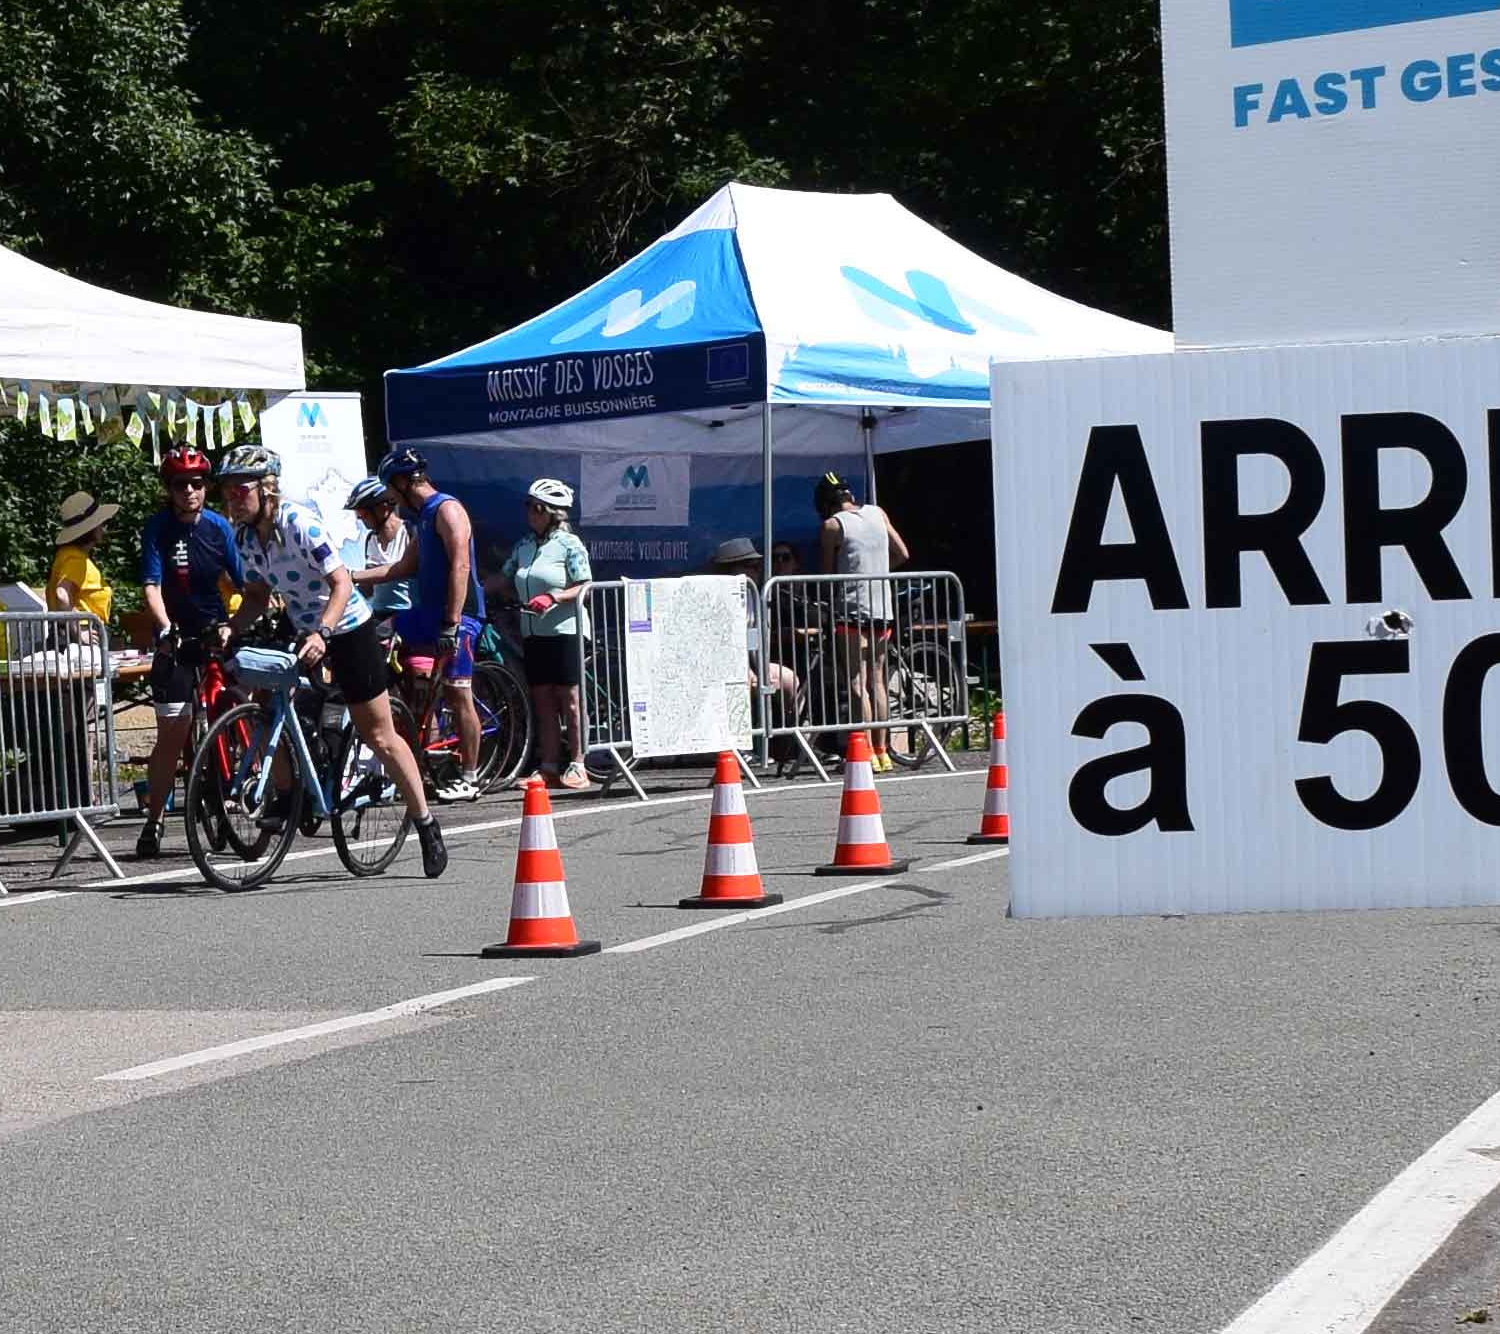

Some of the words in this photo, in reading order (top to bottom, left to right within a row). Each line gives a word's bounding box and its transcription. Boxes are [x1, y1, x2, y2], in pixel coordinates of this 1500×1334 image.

[1232, 66, 1386, 128] FAST
[486, 362, 549, 402] MASSIF
[554, 359, 584, 395] DES
[592, 351, 655, 391] VOSGES
[488, 405, 560, 424] MONTAGNE
[563, 395, 656, 418] BUISSONNIÈRE
[1068, 642, 1195, 837] à
